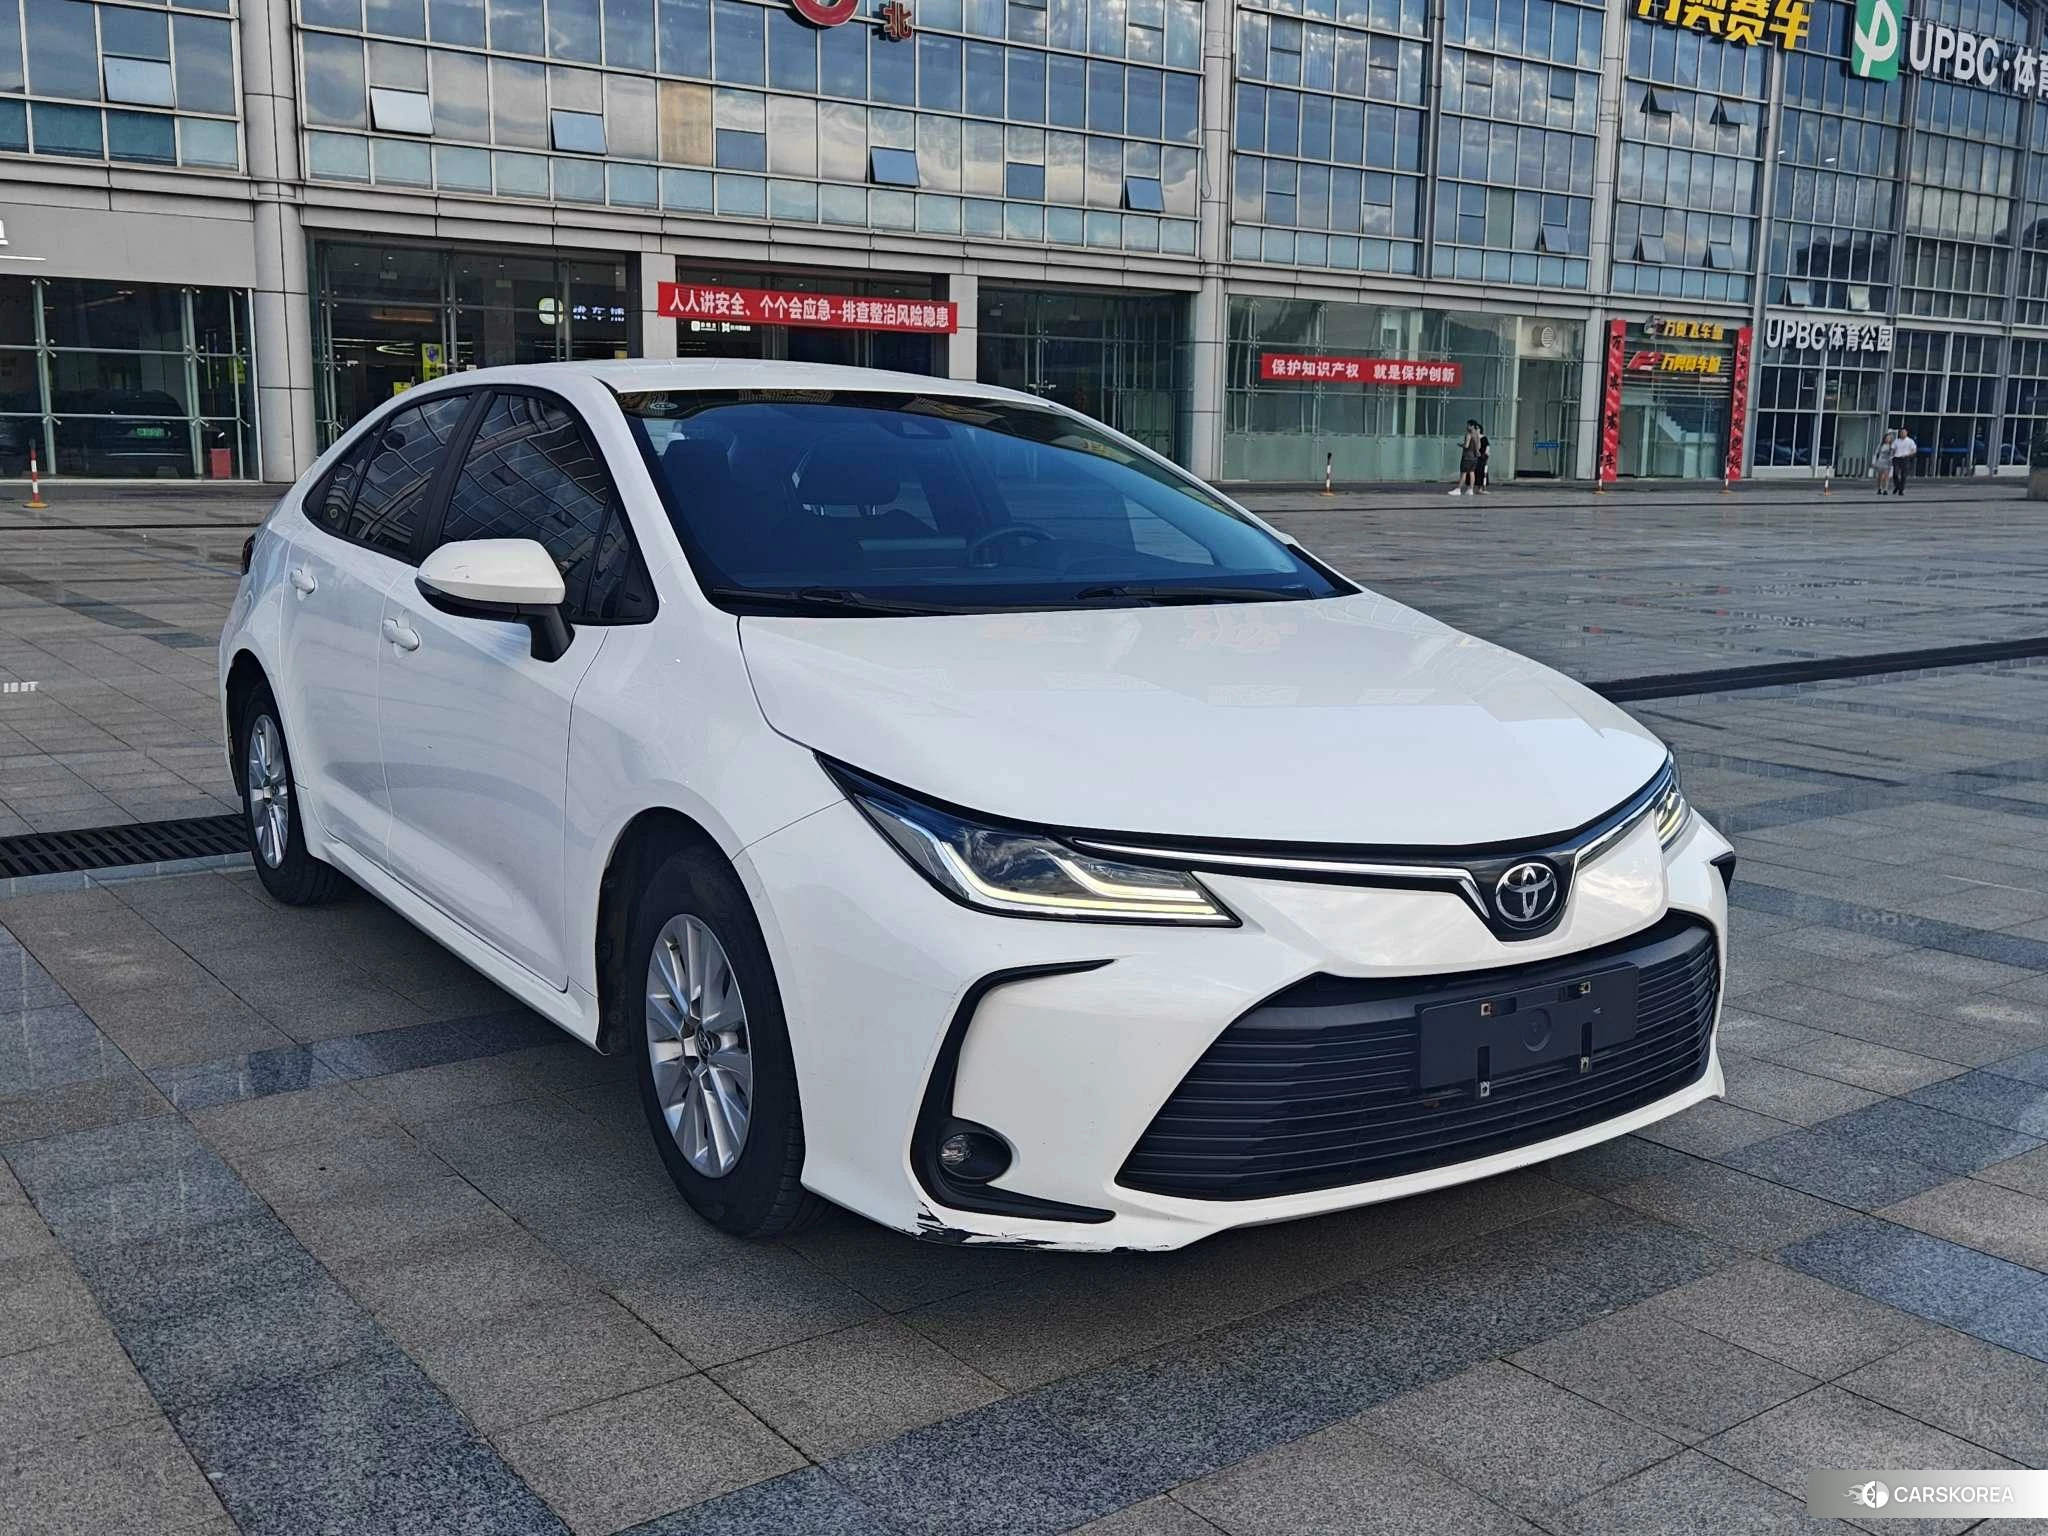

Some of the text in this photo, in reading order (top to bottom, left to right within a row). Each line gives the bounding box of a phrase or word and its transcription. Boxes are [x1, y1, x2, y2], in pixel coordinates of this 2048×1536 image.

[1271, 358, 1455, 382] 保护知识产权 就是保护创新
